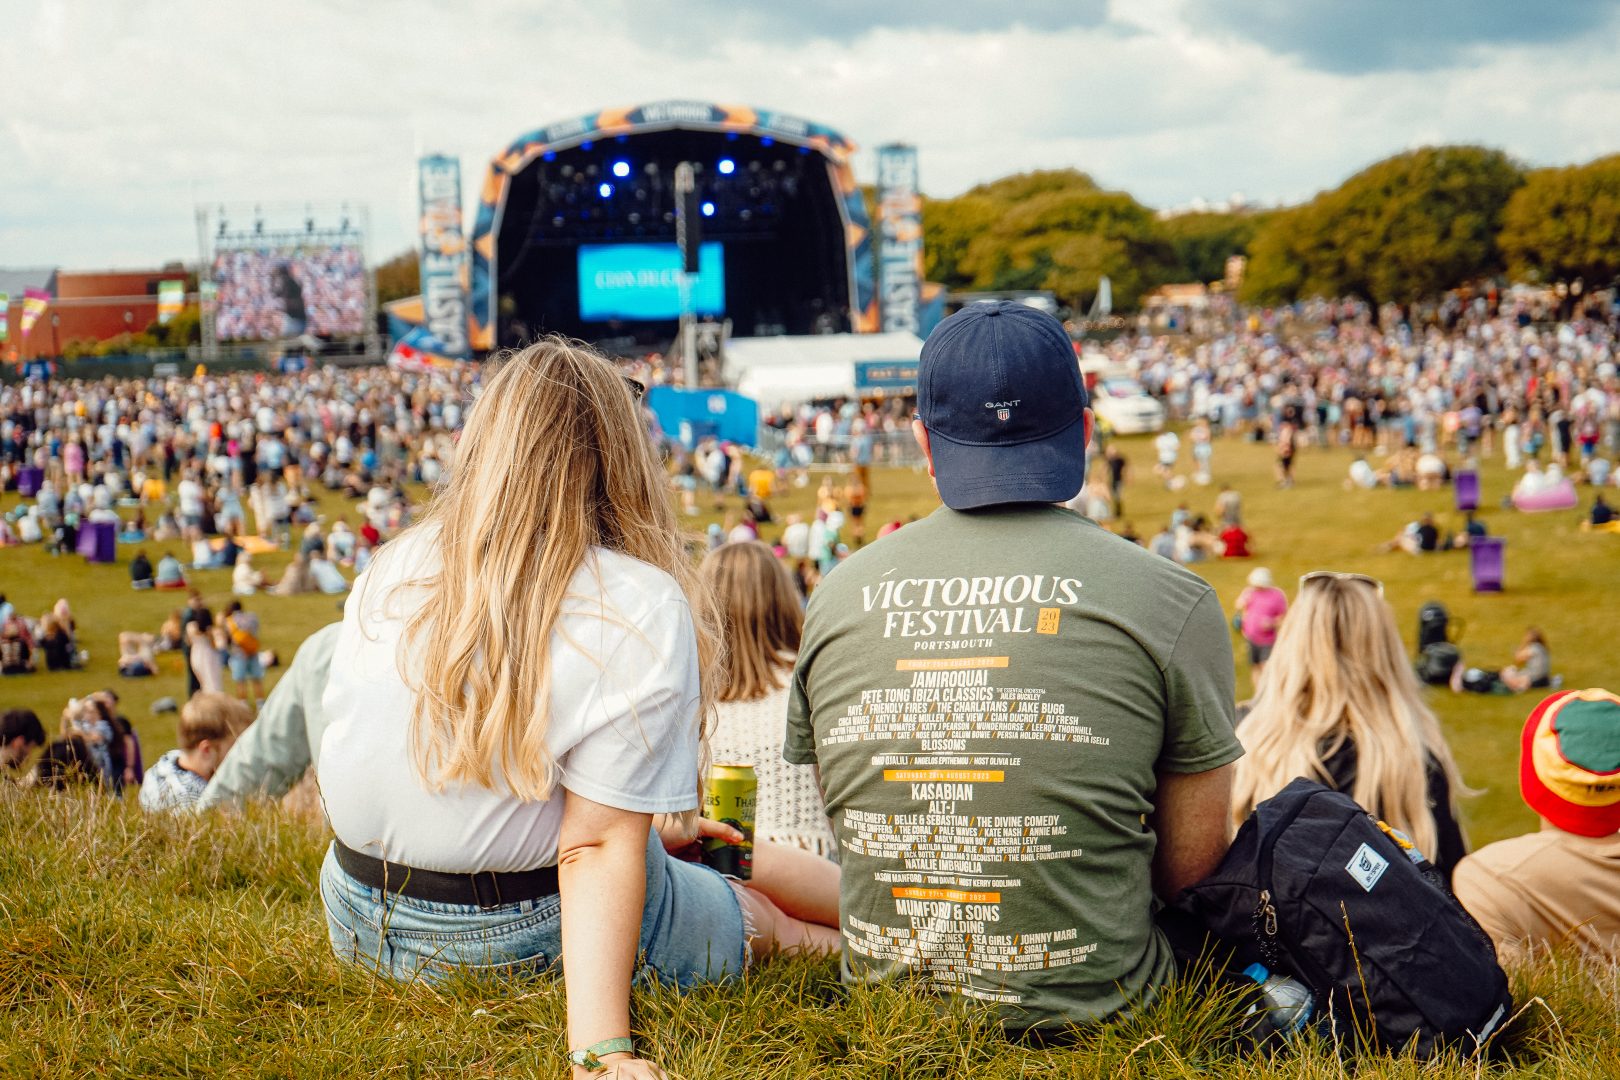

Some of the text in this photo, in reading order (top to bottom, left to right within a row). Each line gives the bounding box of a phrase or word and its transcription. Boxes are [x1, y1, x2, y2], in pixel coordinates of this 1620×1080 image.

[985, 400, 1021, 408] GANT
[862, 575, 1083, 611] VICTORIOUS
[883, 607, 1032, 638] FESTIVAL
[914, 638, 993, 650] PORTSMOUTH
[910, 669, 988, 688] JAMIROQUAI
[861, 687, 993, 704] PETE TONG IBIZA CLASSICS
[847, 702, 1065, 716] RAYE FRIENDLY FIRES THE CHARLATANS JAKE BUGG
[876, 714, 891, 723] KATY
[903, 714, 918, 723] MAE
[919, 714, 945, 722] MULLER
[952, 713, 965, 722] THE
[966, 713, 984, 722] VIEW
[991, 713, 1008, 722] CIAN
[1010, 714, 1038, 723] DUCROT
[1046, 715, 1055, 724] DJ
[1056, 715, 1079, 725] FRESH
[921, 722, 937, 731] KATY
[942, 722, 970, 731] PEARSON
[976, 722, 1024, 731] WUNDERHORSE
[1031, 724, 1056, 732] LEEROY
[1058, 725, 1092, 735] THORNHILL
[915, 731, 929, 739] ROSE
[971, 731, 991, 739] BOWIE
[996, 731, 1018, 739] PERSIA
[1020, 732, 1044, 740] HOLDER
[1072, 734, 1090, 744] SOFIA
[1090, 736, 1110, 746] ISELLA
[921, 738, 966, 751] BLOSSOMS
[974, 757, 989, 765] HOST
[1009, 757, 1021, 766] LEE
[911, 783, 973, 801] KASABIAN
[928, 800, 955, 814] ALT-J
[894, 814, 918, 825] BELLE
[926, 814, 968, 826] SEBASTIAN
[976, 816, 993, 827] THE
[994, 816, 1023, 827] DIVINE
[1024, 814, 1060, 827] COMEDY
[899, 825, 1067, 837] THE CORAL PALE WAVES KATE NASH ANNIE MAC
[993, 836, 1021, 845] GENERAL
[1022, 836, 1038, 845] LEVY
[983, 845, 996, 853] TOM
[996, 845, 1020, 853] SPEIGHT
[1008, 854, 1020, 862] THE
[1036, 850, 1071, 861] FOUNDATION
[904, 859, 982, 873] NATALIE IMBRUGLIA
[973, 878, 991, 887] KERRY
[991, 879, 1021, 888] GODLIMAN
[969, 893, 986, 901] 2023
[895, 899, 1000, 922] MUMFORD & SONS
[910, 917, 985, 934] ELLIE GOULDING
[886, 927, 910, 939] SIGRID
[971, 935, 987, 945] SEA
[988, 935, 1012, 946] GIRLS
[1020, 932, 1052, 945] JOHNNY
[1053, 928, 1078, 942] MARR
[944, 943, 967, 952] SMALL
[973, 945, 986, 954] THE
[999, 946, 1018, 955] TEAM
[1024, 943, 1048, 953] SIGALA
[970, 953, 981, 962] THE
[1014, 953, 1044, 963] COURTING
[1071, 943, 1098, 956] KEMPLAY
[1013, 963, 1028, 972] BOYS
[1029, 961, 1044, 970] CLUB
[1049, 957, 1072, 968] NATALIE
[1072, 954, 1087, 964] SHAY
[933, 970, 966, 983] HARD FI
